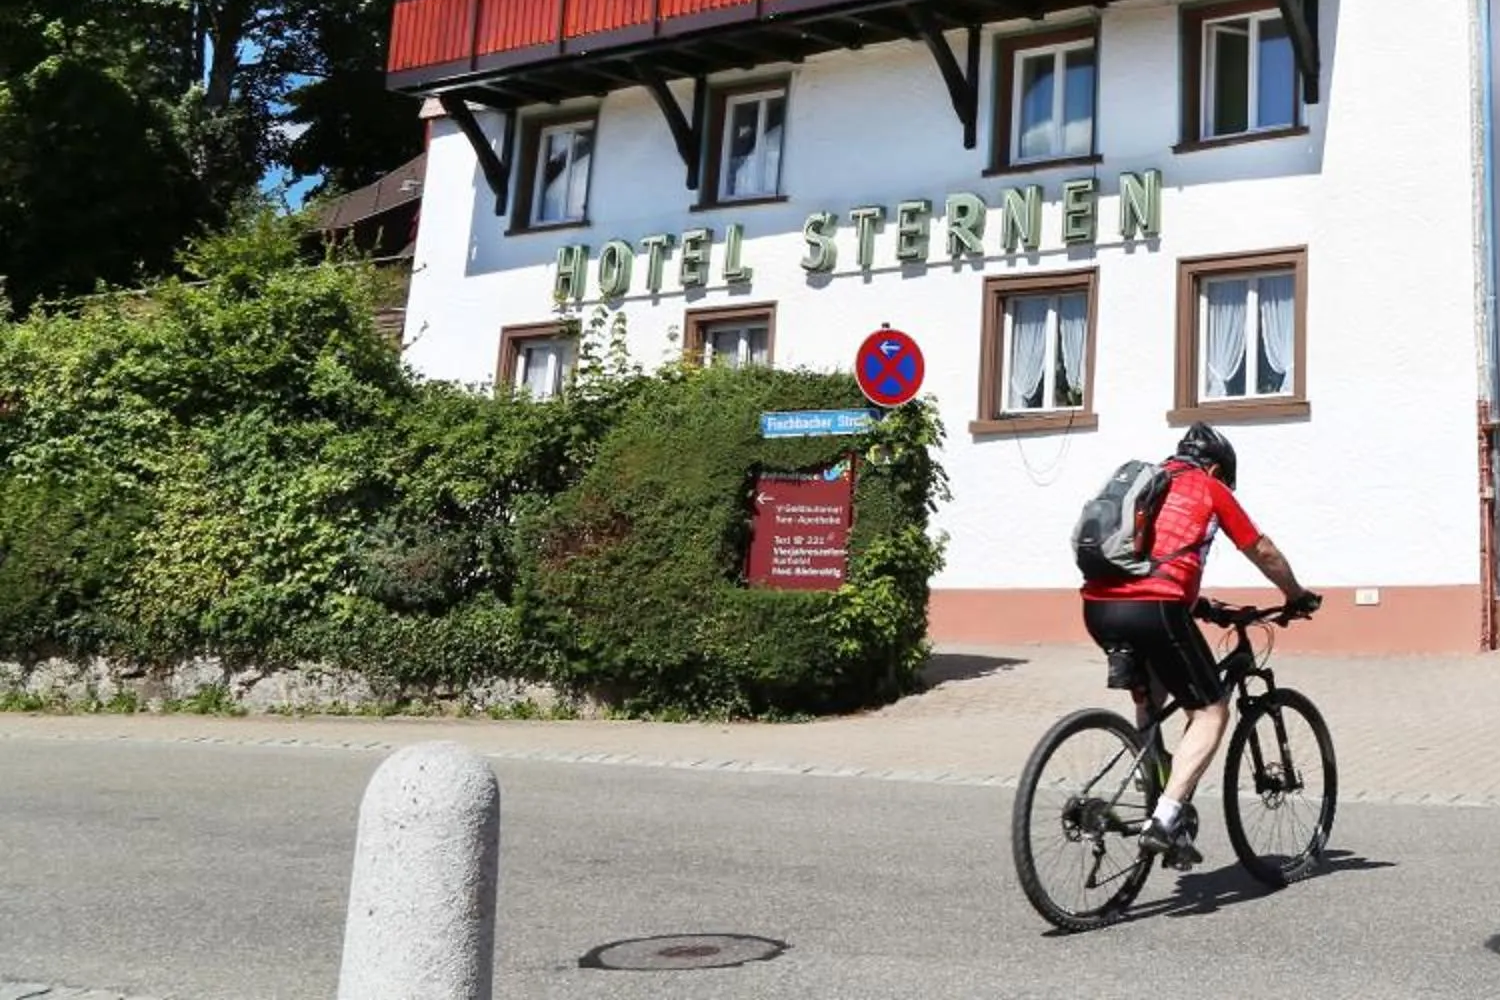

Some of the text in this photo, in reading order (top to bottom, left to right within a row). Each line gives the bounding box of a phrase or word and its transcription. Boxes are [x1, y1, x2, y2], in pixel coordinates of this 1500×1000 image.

[553, 168, 1163, 300] HOTEL STERNEN
[766, 413, 832, 431] Fischbacher
